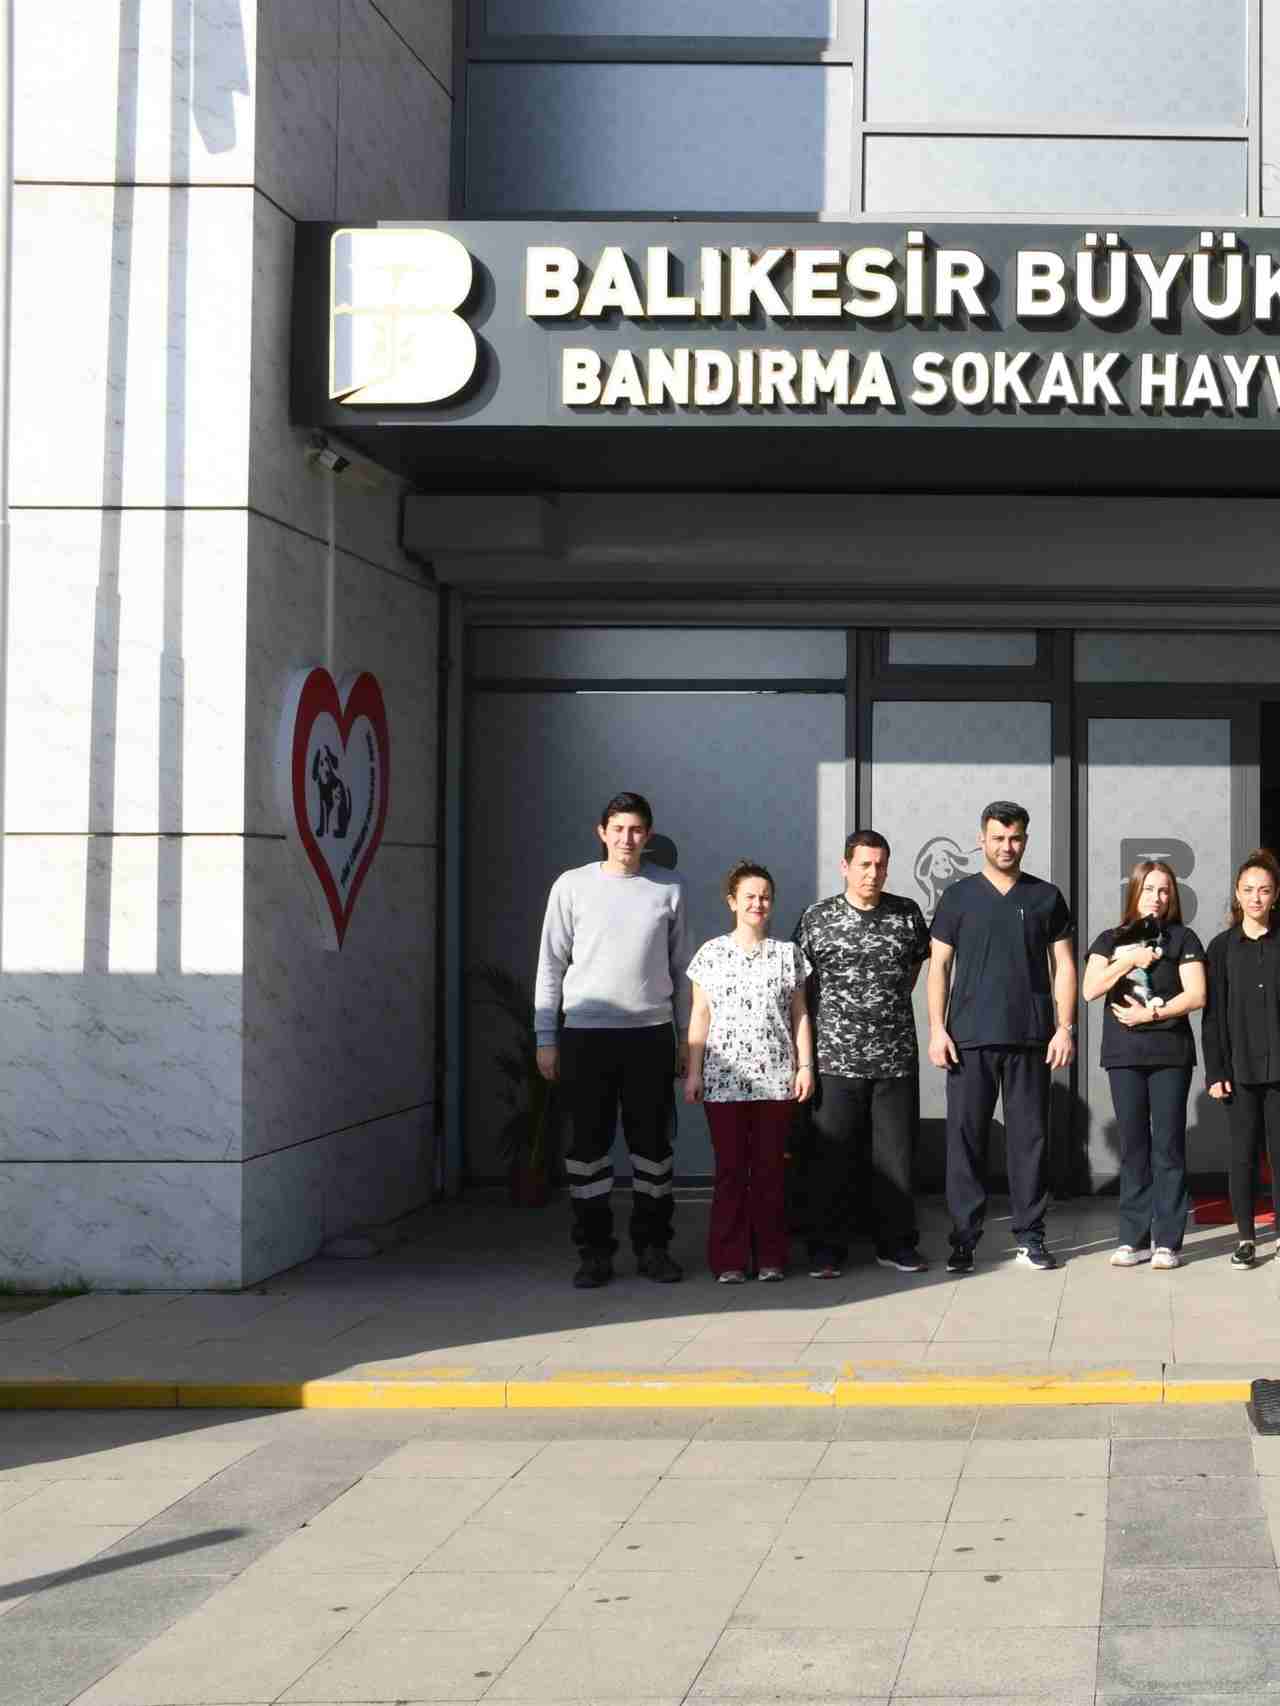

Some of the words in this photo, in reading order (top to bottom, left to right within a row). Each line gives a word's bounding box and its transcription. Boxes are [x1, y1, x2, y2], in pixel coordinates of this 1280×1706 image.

[526, 230, 986, 317] BALIKESİR
[562, 348, 896, 406] BANDIRMA
[910, 350, 1121, 405] SOKAK
